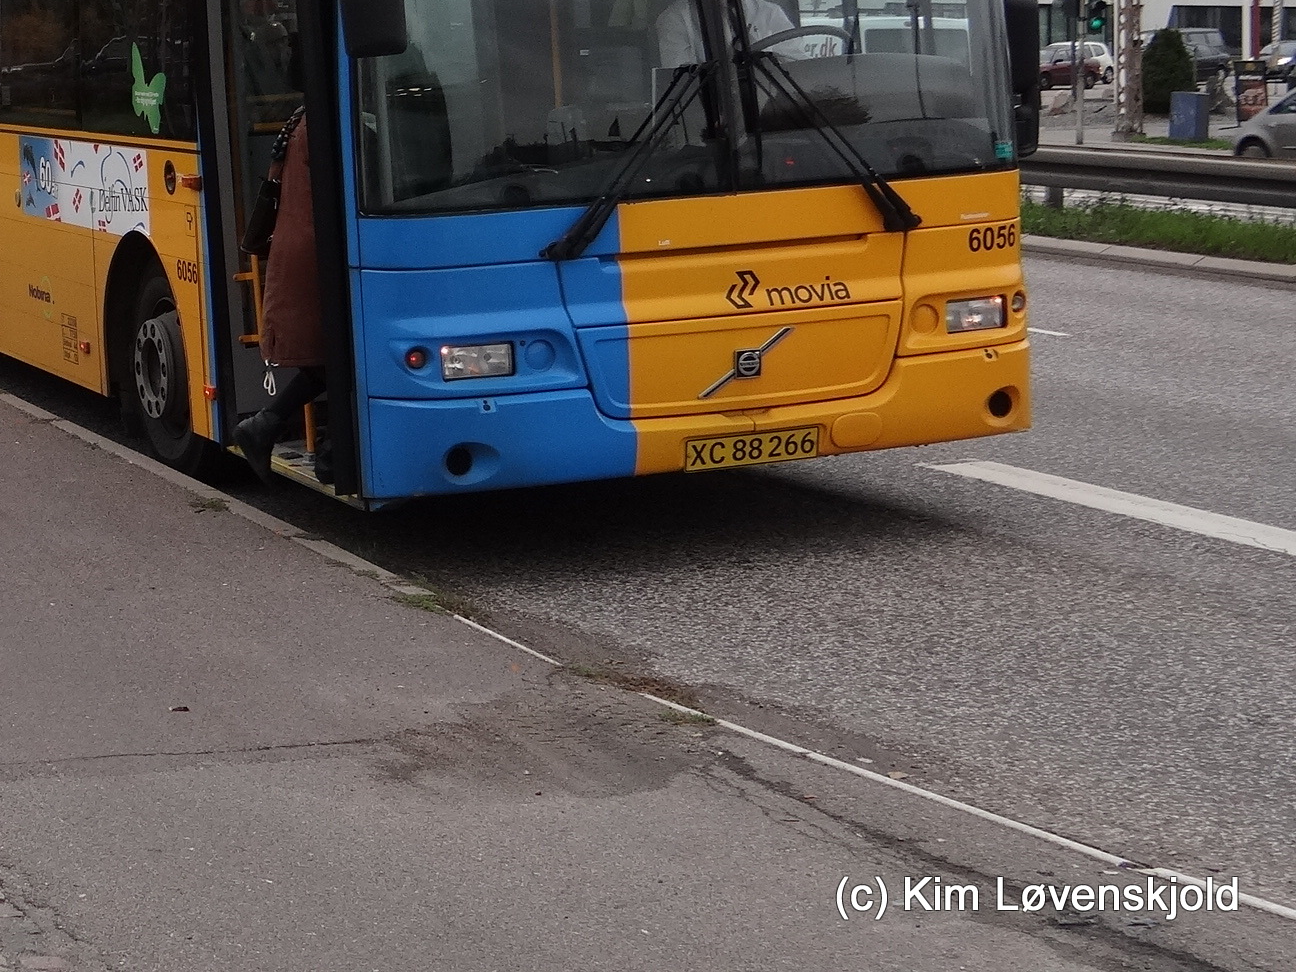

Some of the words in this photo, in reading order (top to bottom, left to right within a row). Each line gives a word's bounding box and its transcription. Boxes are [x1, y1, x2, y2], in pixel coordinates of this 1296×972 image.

[39, 156, 52, 196] 60
[968, 223, 1016, 253] 6056
[176, 259, 198, 284] 6056
[765, 275, 851, 307] movia
[690, 443, 726, 467] XC
[731, 437, 764, 462] 88
[767, 430, 816, 458] 266
